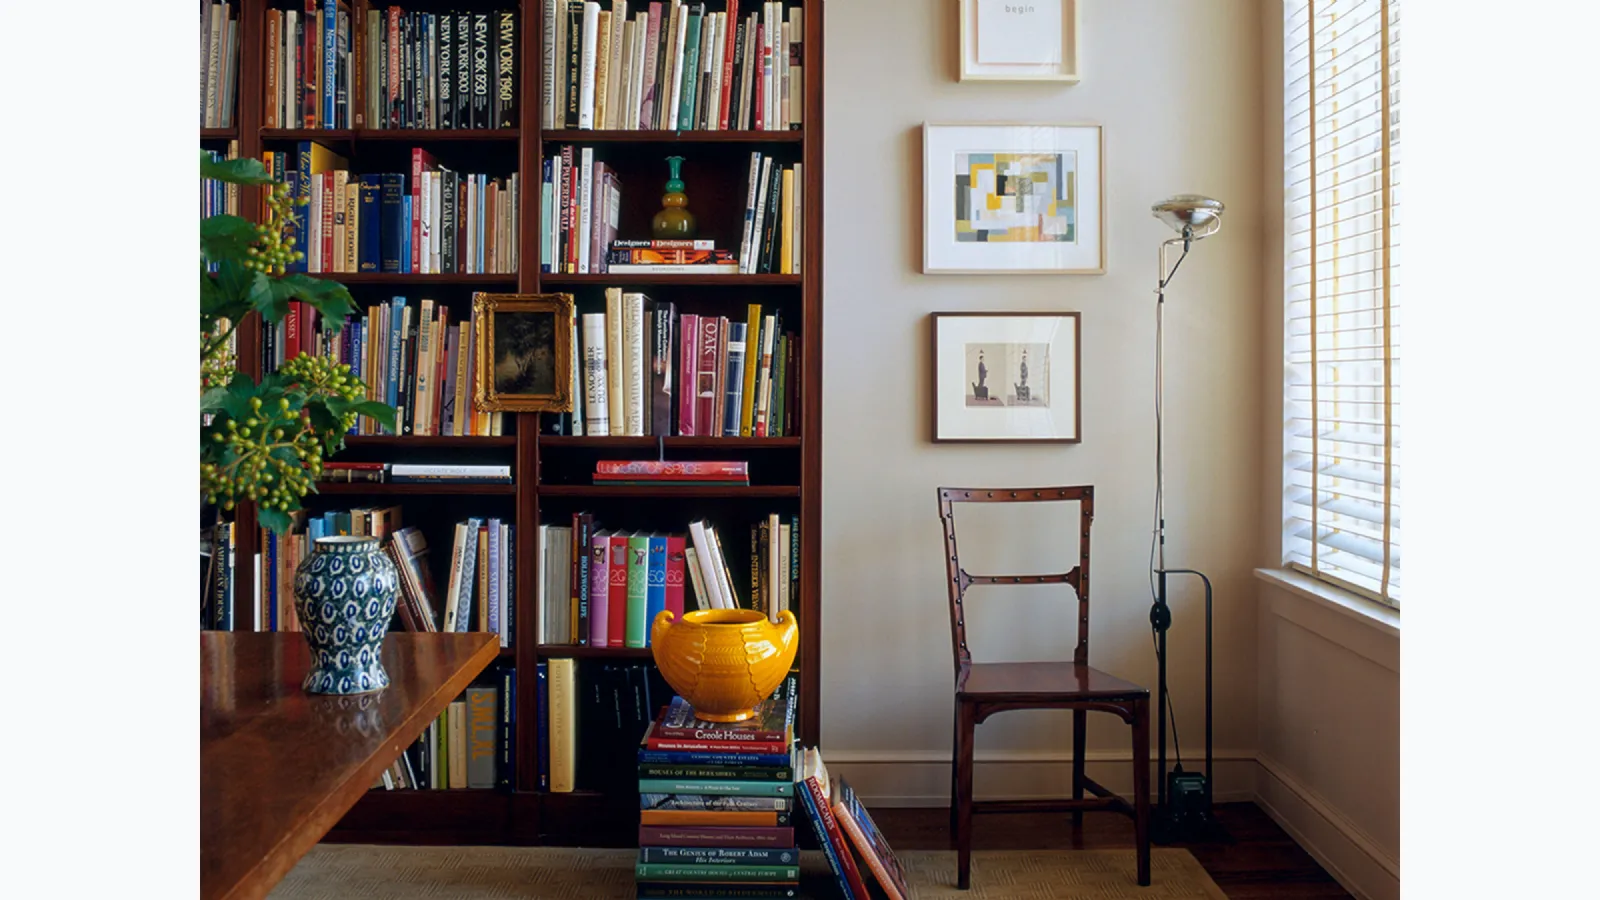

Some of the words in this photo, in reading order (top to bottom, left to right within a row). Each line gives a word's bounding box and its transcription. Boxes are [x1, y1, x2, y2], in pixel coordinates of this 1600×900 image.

[390, 11, 399, 28] NEW
[615, 4, 623, 32] PERIOD
[1005, 4, 1035, 14] begin
[326, 29, 335, 46] New
[390, 31, 399, 50] YORK
[440, 15, 451, 42] NEW
[458, 16, 469, 42] NEW
[475, 15, 487, 43] NEW
[499, 13, 513, 42] NEW
[571, 24, 580, 52] HOMES
[326, 47, 335, 64] York
[440, 44, 451, 75] YORK
[458, 43, 469, 70] YORK
[475, 45, 487, 73] YORK
[499, 43, 513, 75] YORK
[571, 54, 578, 64] OF
[612, 34, 621, 61] ROOMS
[326, 65, 335, 97] Interiors
[390, 53, 399, 99] APARTMENTS
[458, 71, 469, 93] 1900
[474, 74, 487, 95] 1930
[499, 76, 513, 101] 1960
[543, 43, 553, 106] INTERIORS
[570, 68, 578, 84] THE
[208, 71, 218, 109] HOUSES
[440, 78, 450, 100] 1880
[560, 146, 571, 165] THE
[444, 182, 453, 199] 740
[560, 166, 571, 208] PAPERED
[348, 198, 356, 228] RIGHT
[443, 202, 453, 229] PARK
[560, 208, 570, 233] WALL
[347, 230, 356, 265] PEOPLE
[614, 240, 651, 248] Designers
[656, 240, 693, 248] Designers
[288, 310, 297, 339] JANSEN
[631, 295, 642, 342] AMERICAN
[392, 330, 401, 348] Paris
[704, 323, 718, 356] OAK
[390, 350, 400, 383] Interiors
[587, 346, 597, 392] MOBILIER
[631, 346, 642, 406] DECORATIVE
[588, 395, 597, 404] LE
[631, 410, 642, 434] ARTS
[600, 464, 642, 473] LUXURY
[647, 464, 663, 473] OF
[665, 464, 701, 475] SPACE
[490, 532, 498, 559] STYLE
[791, 533, 799, 580] DECORATOR
[216, 545, 225, 587] AMERICAN
[580, 555, 588, 601] HOLLYWOOD
[751, 554, 759, 588] INTERIOR
[216, 589, 225, 622] HOUSES
[489, 571, 498, 621] SALADINO
[580, 602, 588, 618] LIFE
[695, 731, 724, 741] Creole
[724, 732, 756, 742] Houses
[808, 777, 835, 831] ROOMSCAPES
[813, 819, 825, 843] Interior
[823, 842, 840, 877] Inspirations
